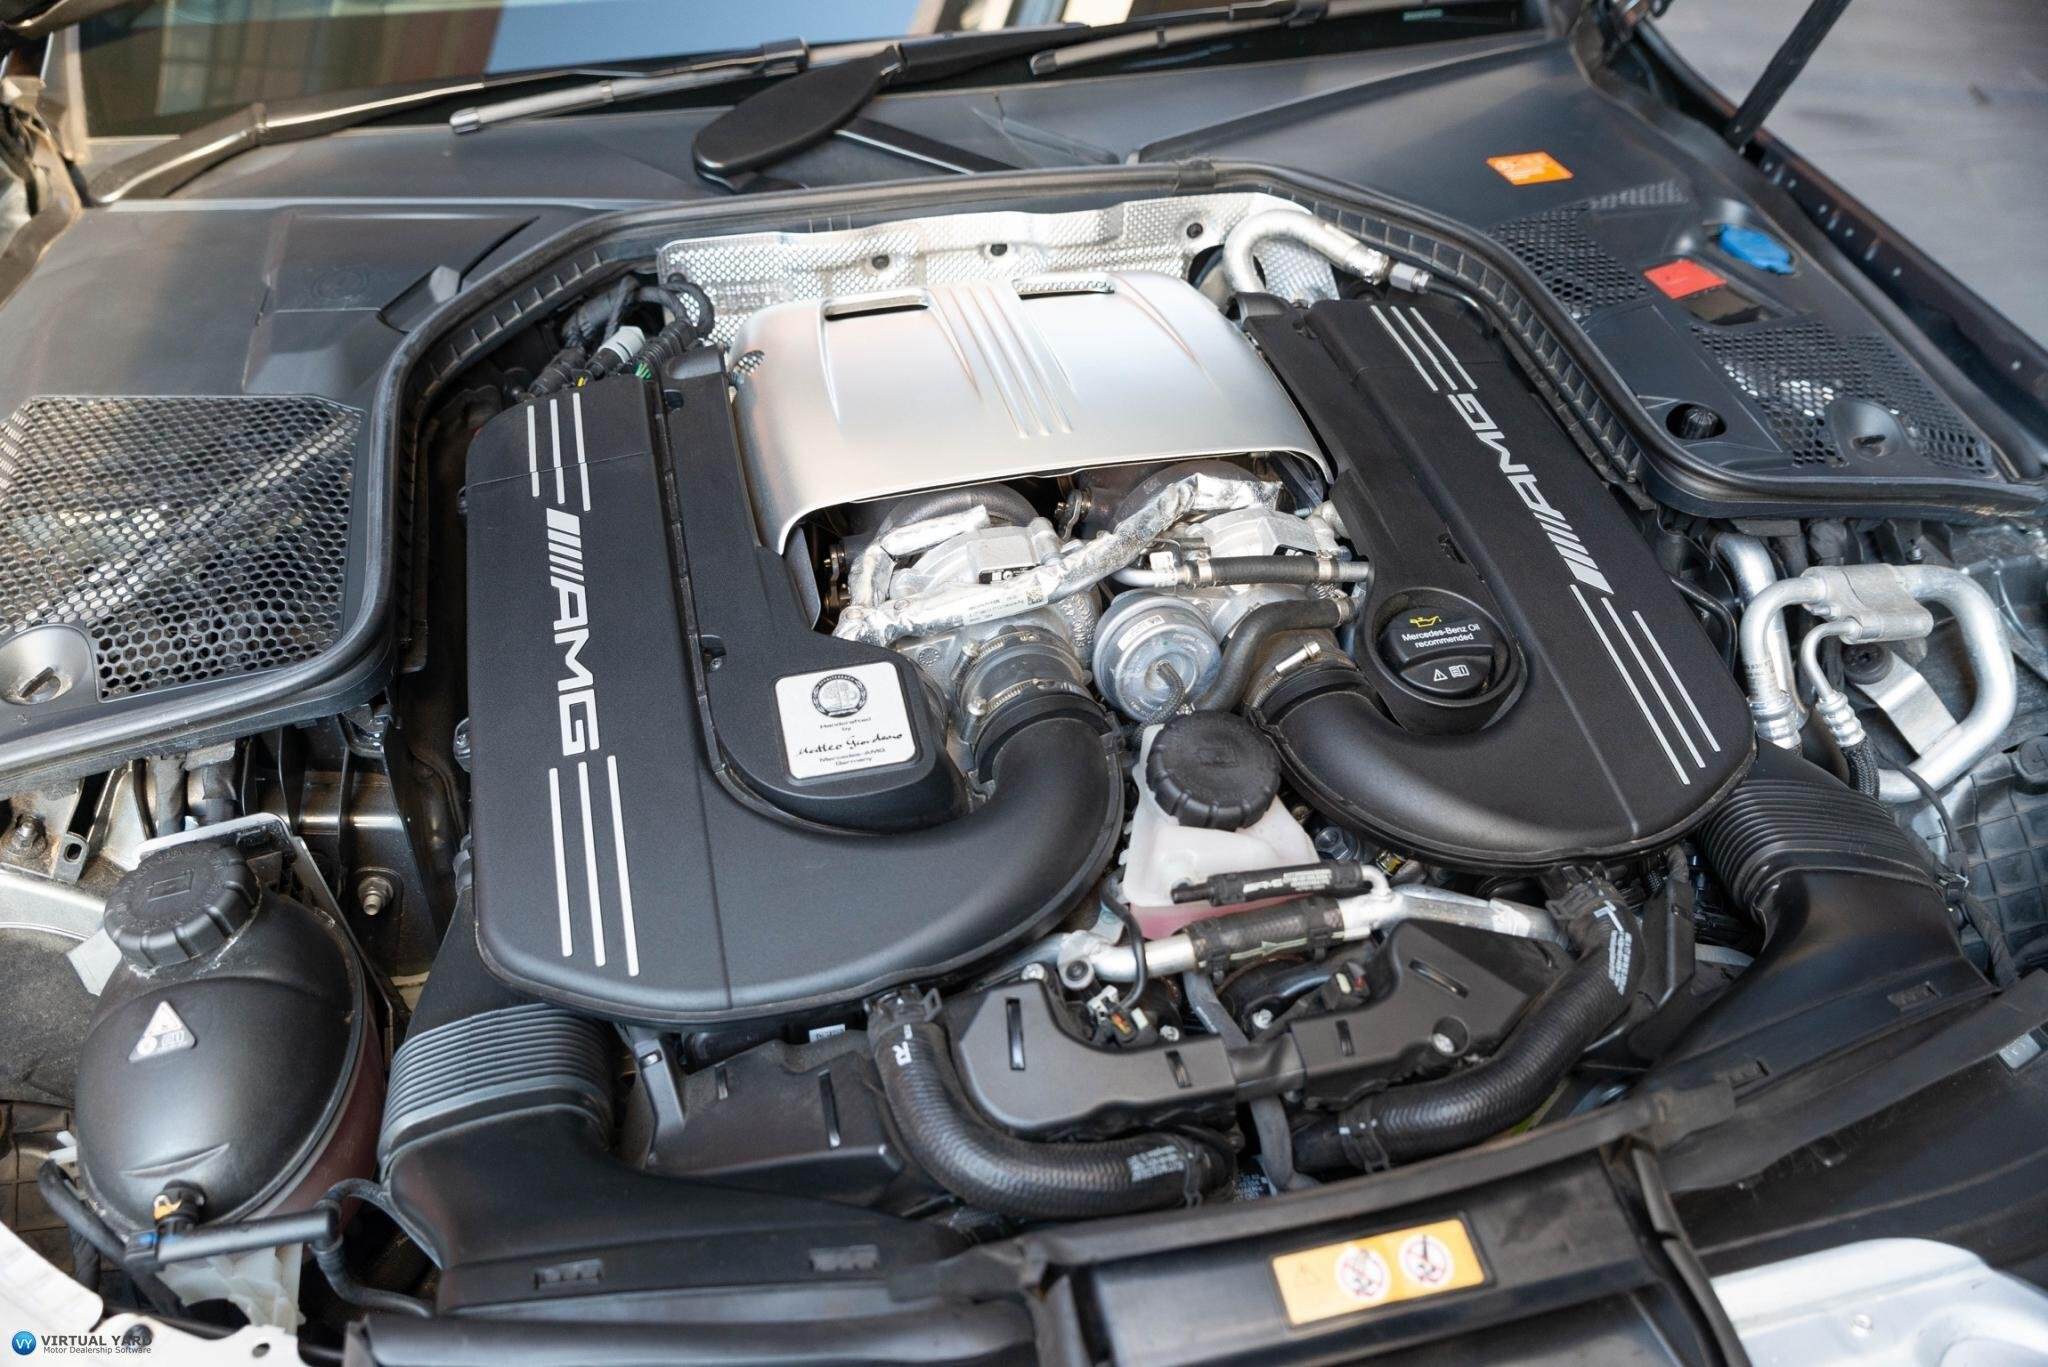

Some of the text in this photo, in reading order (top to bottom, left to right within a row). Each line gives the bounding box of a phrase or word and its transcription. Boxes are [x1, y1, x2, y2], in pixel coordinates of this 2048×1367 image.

[1448, 393, 1566, 521] AMG
[550, 575, 600, 756] AMG
[1401, 623, 1480, 641] Mercedes-Benz Oil
[1414, 633, 1474, 648] recommended
